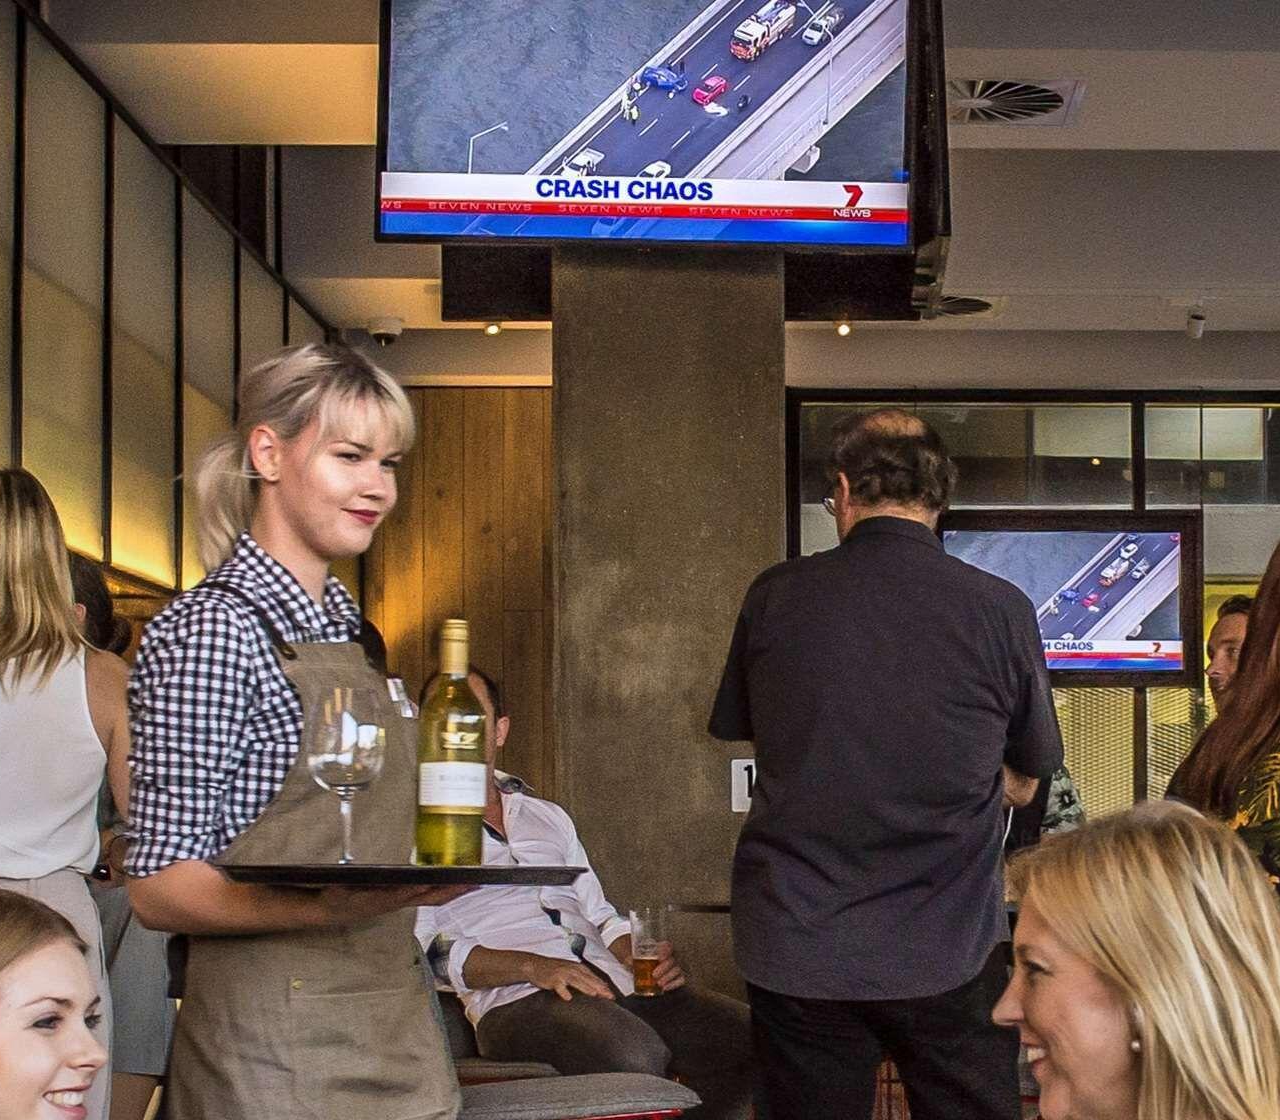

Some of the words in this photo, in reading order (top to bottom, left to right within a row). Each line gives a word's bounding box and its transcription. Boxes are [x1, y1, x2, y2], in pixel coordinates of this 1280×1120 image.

[535, 178, 620, 199] CRASH
[627, 180, 713, 201] CHAOS
[842, 184, 864, 208] 7
[428, 201, 480, 211] SEVEN
[486, 202, 533, 212] NEWS
[558, 203, 611, 213] SEVEN
[616, 204, 664, 214] NEWS
[688, 206, 741, 216] SEVEN
[747, 207, 794, 217] NEWS
[833, 207, 872, 219] NEWS
[1054, 641, 1094, 651] CHAOS
[1152, 642, 1162, 653] 7
